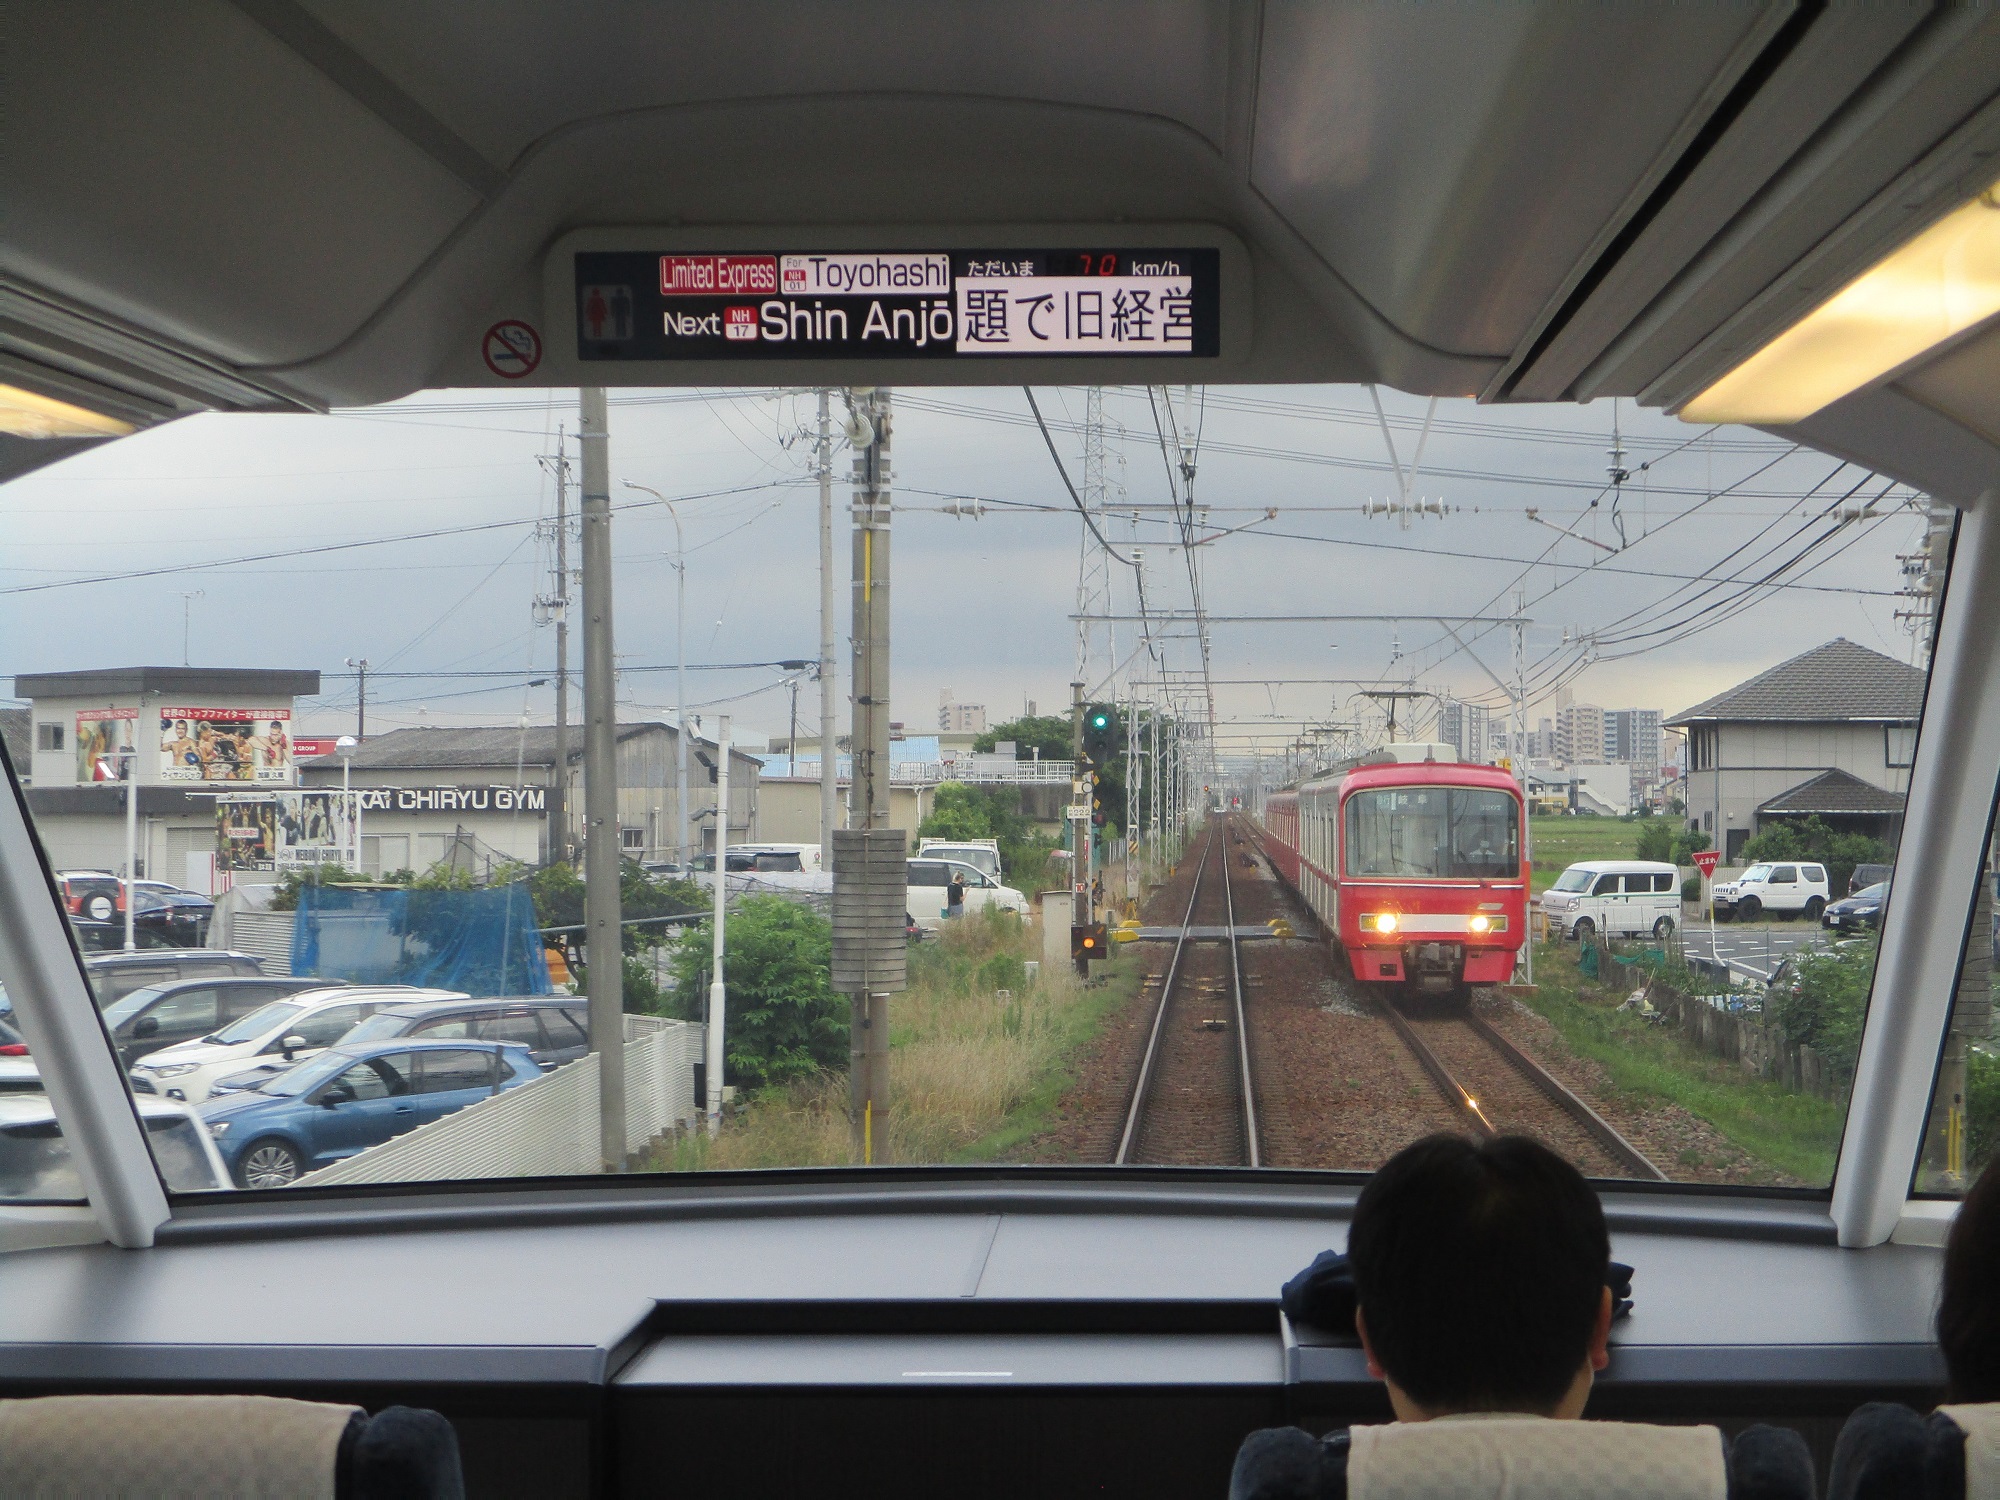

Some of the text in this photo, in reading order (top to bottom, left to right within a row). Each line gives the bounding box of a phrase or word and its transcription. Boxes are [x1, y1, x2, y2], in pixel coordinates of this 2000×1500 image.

[786, 258, 802, 267] For
[968, 260, 1034, 277] ただいま
[1080, 254, 1180, 277] 70 km/h
[663, 258, 775, 293] Limited Express
[788, 271, 801, 280] NH
[808, 257, 947, 292] Toyohashi
[789, 281, 801, 290] 01
[663, 311, 721, 336] Next
[731, 310, 750, 323] NH
[761, 300, 953, 347] Shin Anjō
[964, 286, 1192, 343] 題で旧経営
[733, 325, 749, 337] 17
[398, 790, 488, 809] CHIRYU
[495, 790, 545, 809] GYM
[1698, 856, 1716, 865] 止まれ
